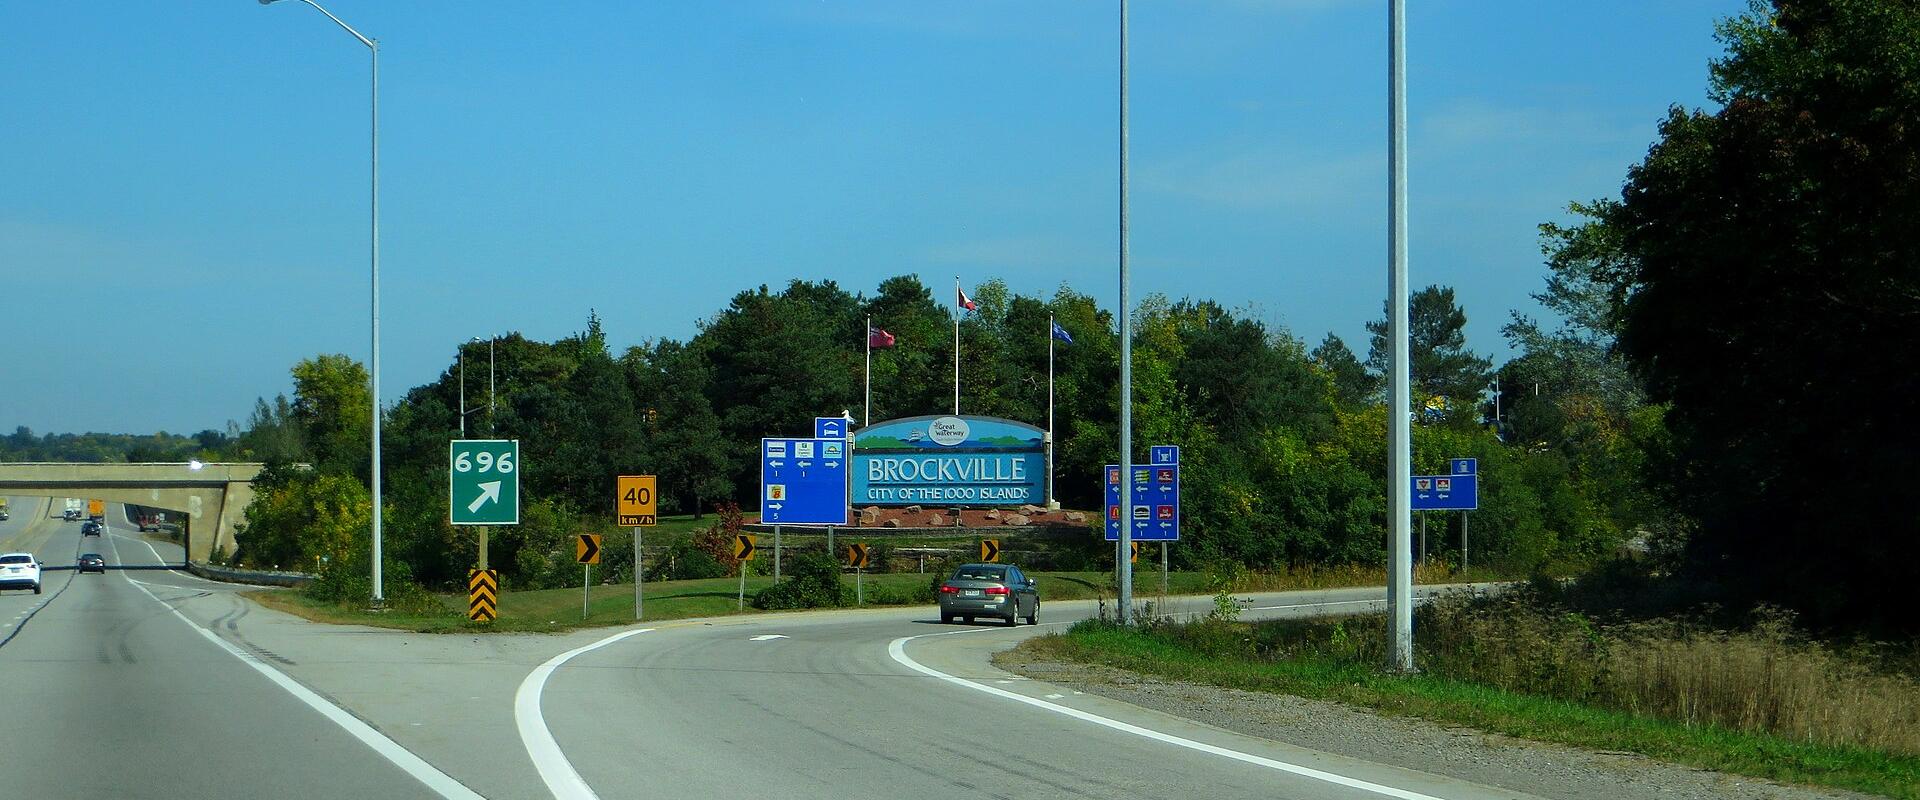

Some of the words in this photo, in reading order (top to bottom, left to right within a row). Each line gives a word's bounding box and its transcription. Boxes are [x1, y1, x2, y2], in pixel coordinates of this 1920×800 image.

[455, 451, 513, 473] 696
[868, 458, 1026, 481] BROCKVILLE
[623, 487, 650, 505] 40
[868, 487, 896, 500] CITY
[898, 487, 916, 500] OF
[917, 487, 942, 500] THE
[944, 487, 975, 500] 1000
[979, 487, 1030, 500] ISLANDS
[621, 515, 653, 525] km/h
